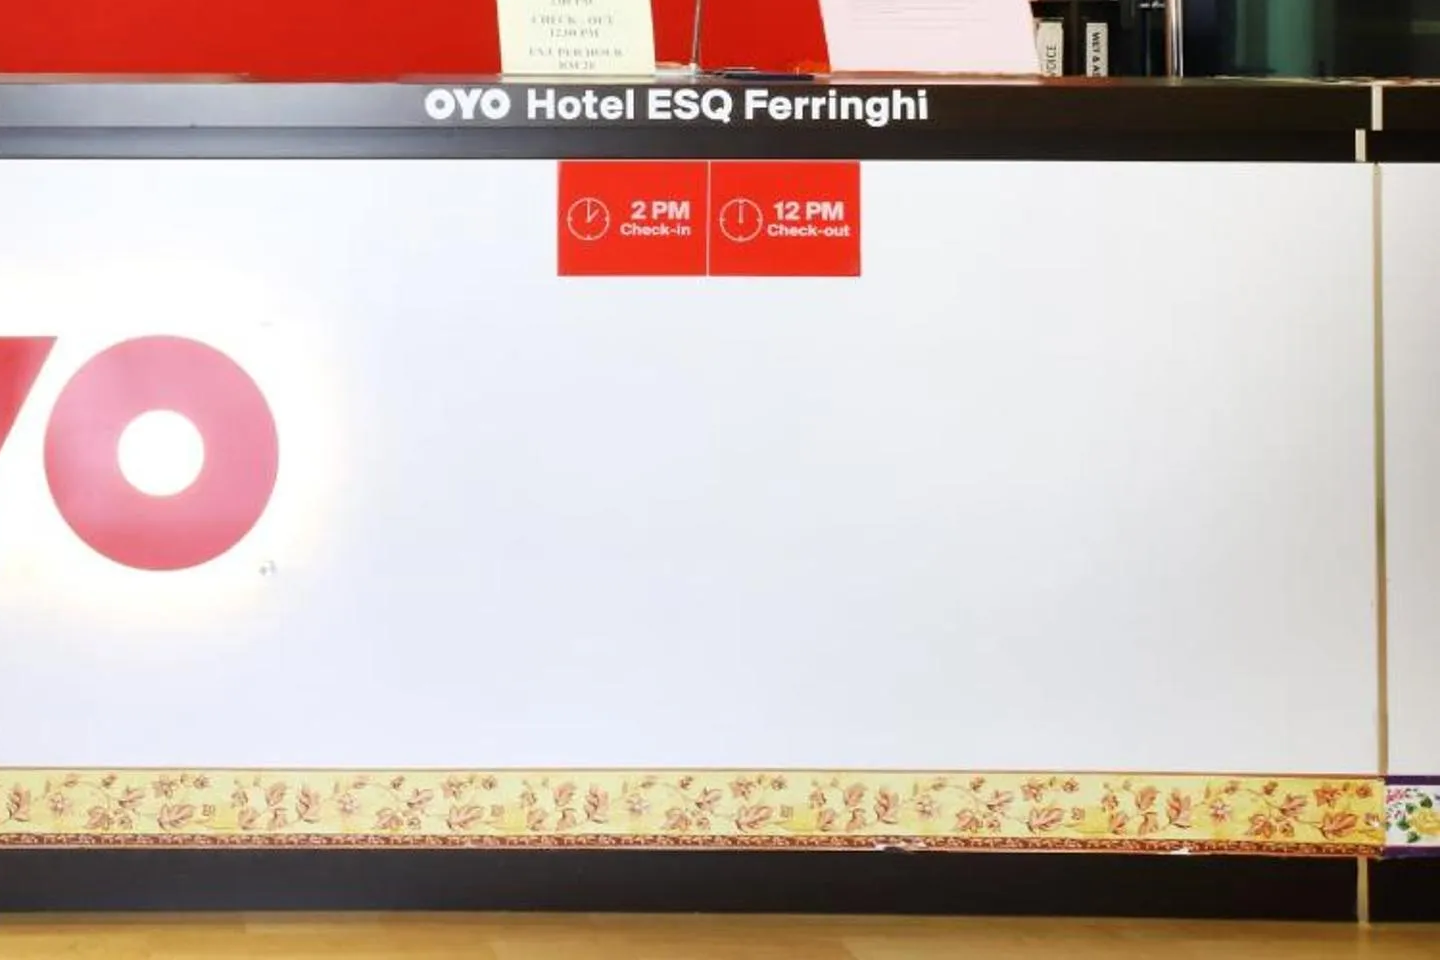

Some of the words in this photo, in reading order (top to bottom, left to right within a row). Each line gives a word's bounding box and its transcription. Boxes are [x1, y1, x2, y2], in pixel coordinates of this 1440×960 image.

[424, 88, 511, 120] OYO
[526, 88, 635, 120] Hotel
[647, 88, 733, 123] ESQ
[744, 88, 928, 127] Ferringhi
[631, 200, 648, 220] 2
[652, 200, 690, 220] PM
[773, 201, 801, 221] 12
[806, 201, 844, 221] PM
[619, 221, 691, 237] Check-in
[767, 222, 850, 238] Check-out
